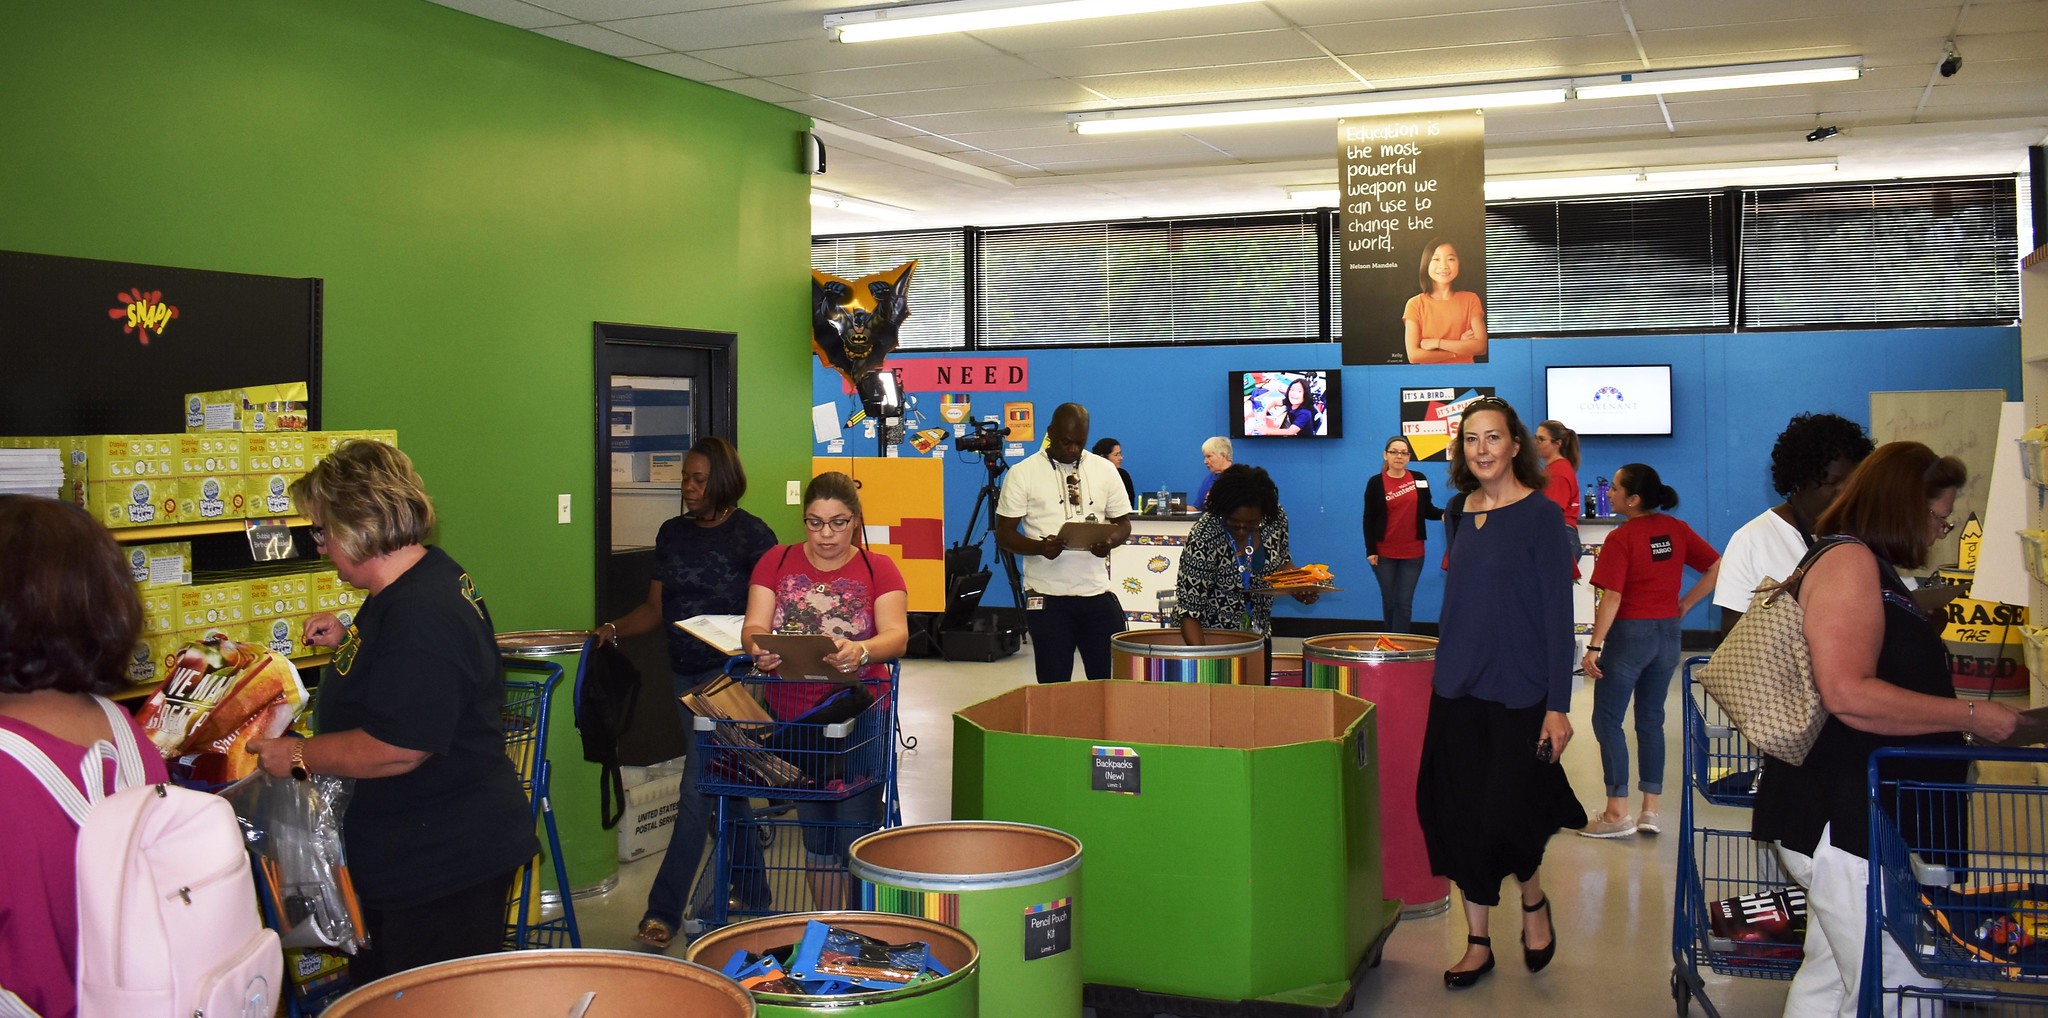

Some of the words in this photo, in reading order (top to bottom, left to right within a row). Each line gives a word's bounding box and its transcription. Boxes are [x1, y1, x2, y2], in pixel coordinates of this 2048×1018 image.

[1346, 122, 1419, 142] Education
[1427, 121, 1440, 136] is
[1347, 145, 1372, 159] the
[1381, 141, 1422, 157] most
[1347, 158, 1416, 184] powerful
[1348, 180, 1406, 201] weapon
[1415, 179, 1437, 193] we
[1348, 201, 1371, 215] can
[1380, 199, 1406, 213] use
[1415, 197, 1431, 211] to
[1348, 218, 1399, 239] change
[1408, 216, 1434, 230] the
[1348, 234, 1395, 252] world.
[127, 299, 172, 335] SNAP!
[1420, 392, 1425, 400] A
[1450, 405, 1457, 413] A
[1580, 402, 1638, 410] COVENANT
[1650, 541, 1671, 549] WELLS
[1652, 547, 1672, 555] FARGO
[1956, 628, 1990, 642] THE
[169, 667, 201, 697] WE
[1096, 758, 1133, 770] Backpacks
[1105, 771, 1125, 781] (New)
[638, 809, 658, 823] UNITED
[635, 821, 657, 836] POSTAL
[1031, 915, 1050, 928] Pencil
[1052, 910, 1067, 924] Pouch
[1047, 929, 1055, 939] Kit
